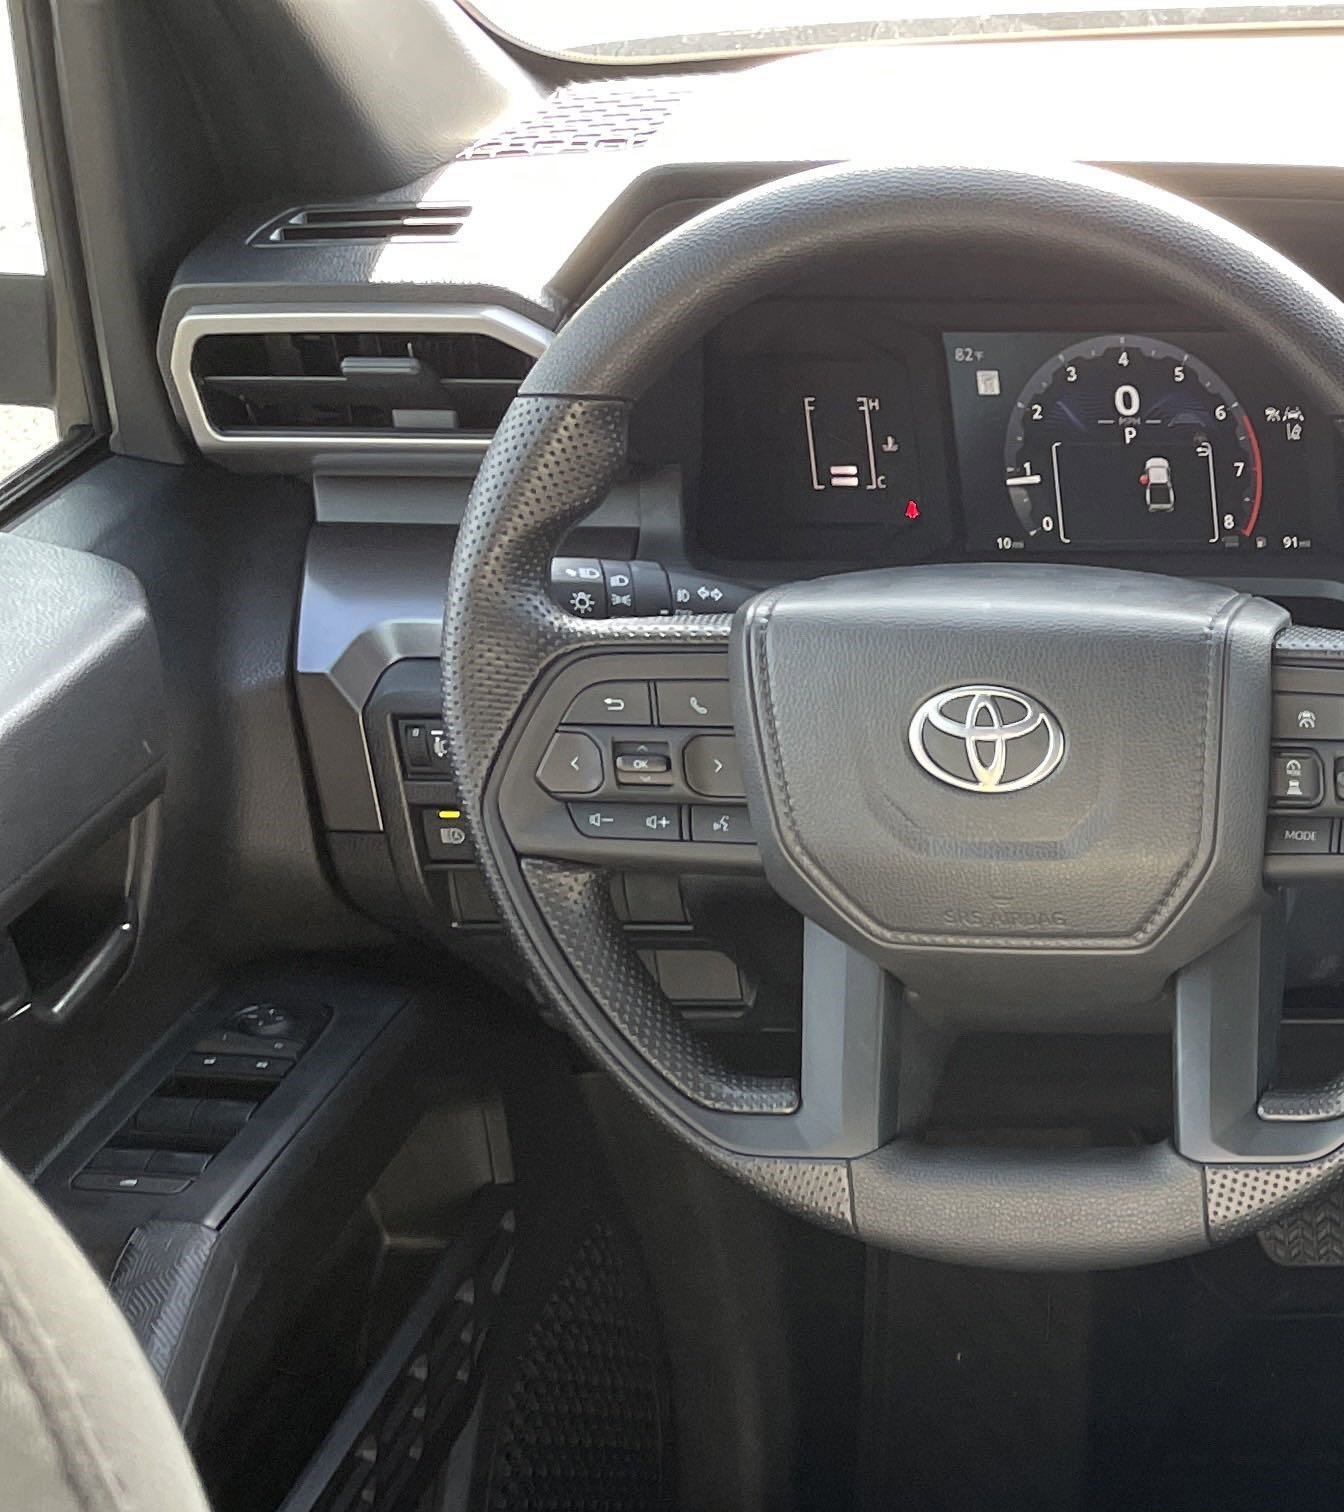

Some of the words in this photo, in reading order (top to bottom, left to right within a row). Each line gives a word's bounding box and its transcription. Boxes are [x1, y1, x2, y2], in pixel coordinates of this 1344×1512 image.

[1117, 352, 1129, 367] 4
[1066, 366, 1077, 382] 3
[1174, 366, 1185, 382] 5
[868, 398, 880, 411] H
[1114, 384, 1140, 416] 0
[1031, 404, 1043, 420] 2
[1214, 404, 1227, 420] 6
[1124, 427, 1137, 444] P
[1024, 461, 1031, 476] 1
[1233, 462, 1245, 477] 7
[877, 476, 887, 489] C
[1042, 516, 1053, 531] 0
[1223, 514, 1235, 529] 8
[996, 537, 1012, 549] 10
[1282, 536, 1298, 549] 91
[633, 760, 648, 769] OK
[1284, 830, 1317, 841] MODE
